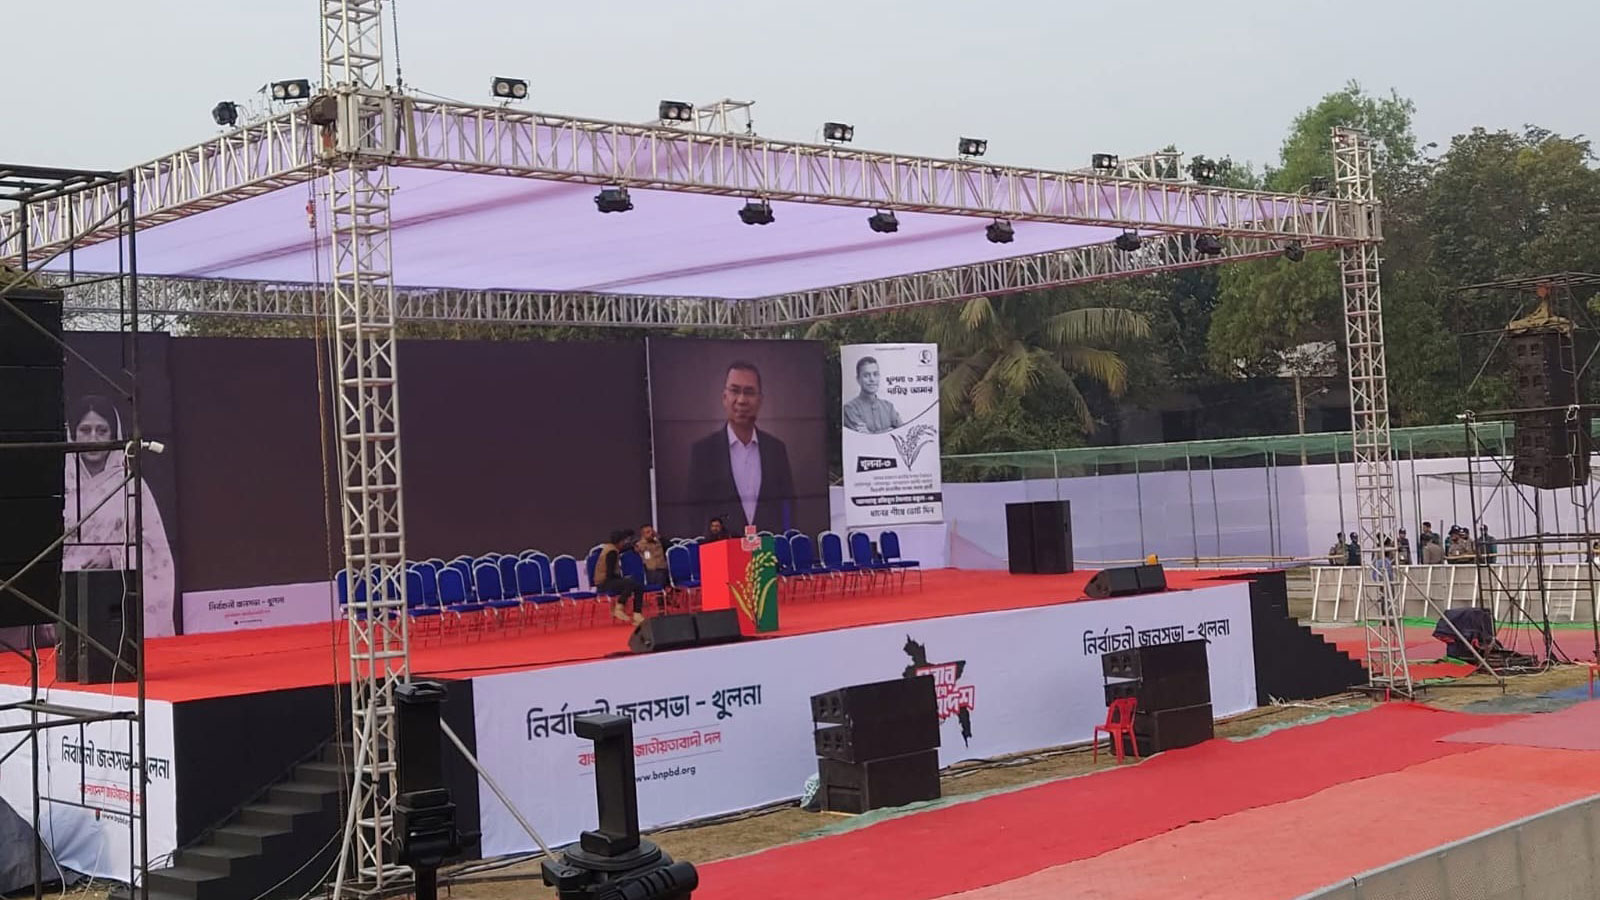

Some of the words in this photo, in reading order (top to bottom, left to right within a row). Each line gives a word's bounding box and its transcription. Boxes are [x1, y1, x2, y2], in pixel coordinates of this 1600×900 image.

[1083, 625, 1135, 656] নির্বাচনী
[1138, 625, 1184, 646] জনসভা
[1198, 619, 1230, 644] খুলনা
[712, 684, 762, 720] খুলনা
[633, 731, 702, 757] জাতীয়তাবাদী
[704, 730, 721, 745] দল
[97, 748, 131, 771] জনসভ
[635, 765, 696, 783] ww.bnpbd.org
